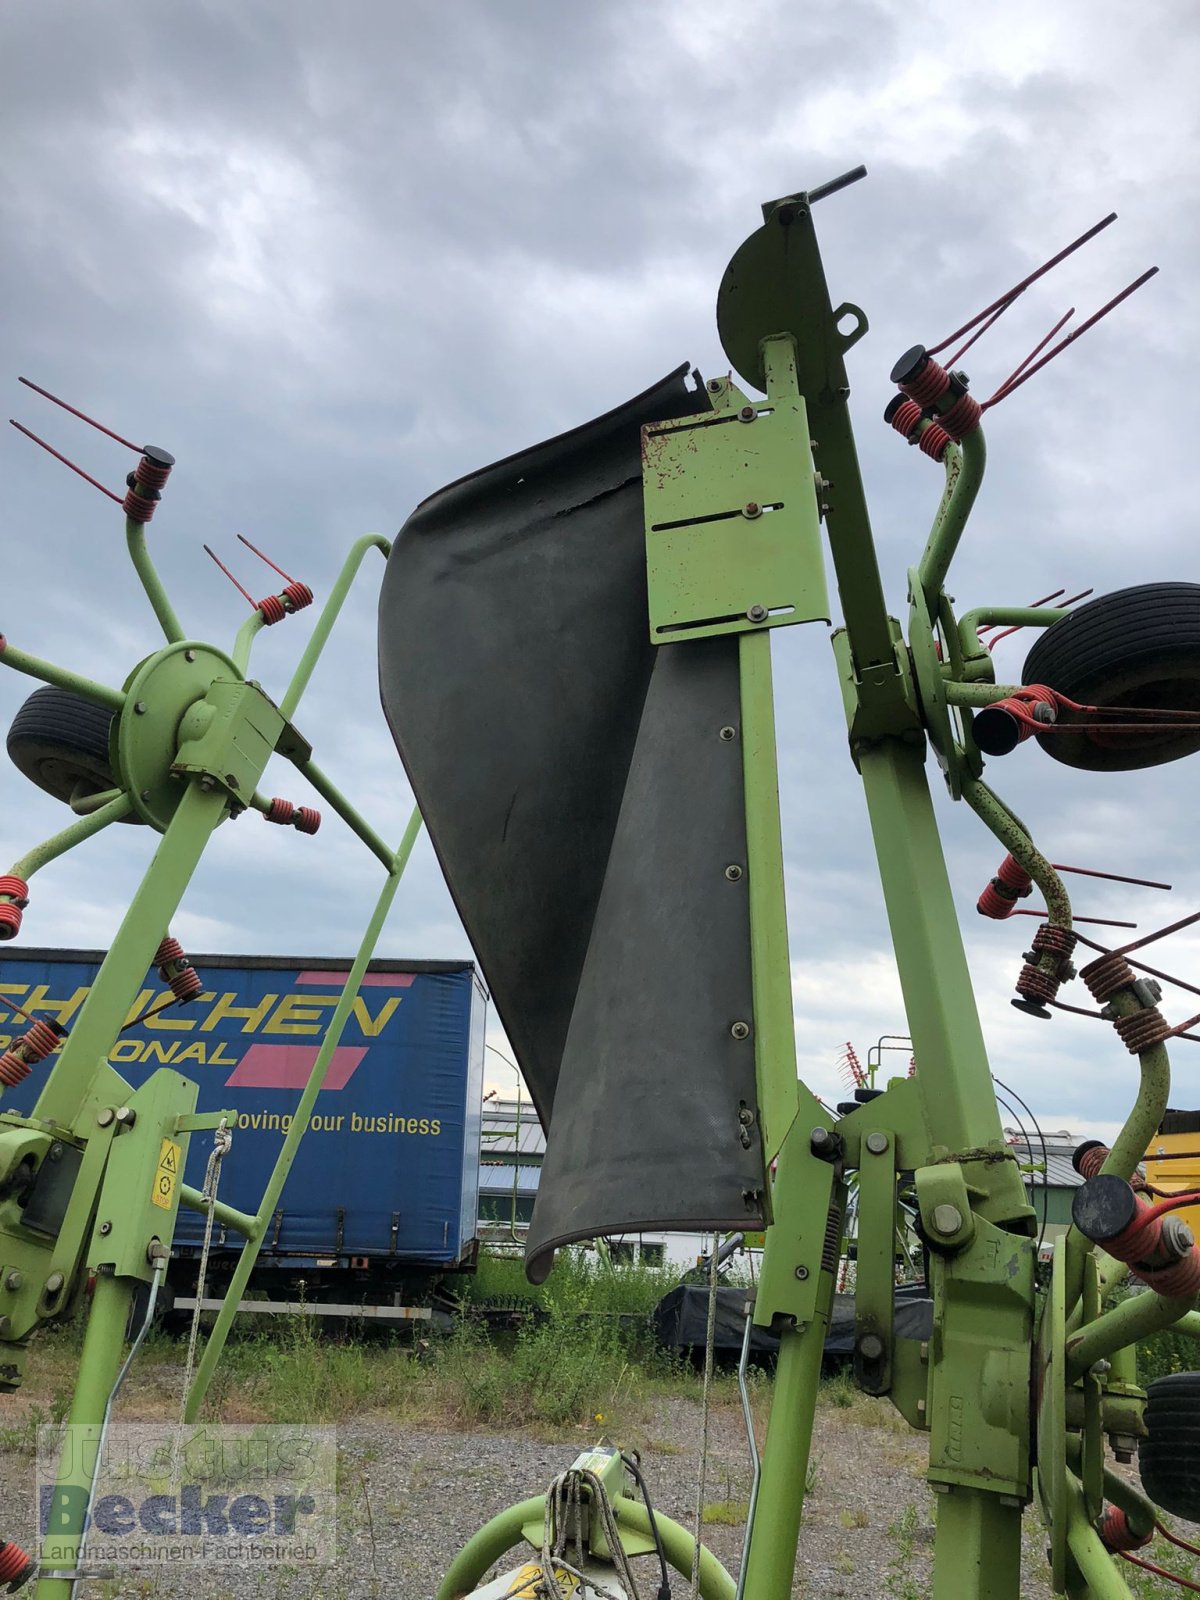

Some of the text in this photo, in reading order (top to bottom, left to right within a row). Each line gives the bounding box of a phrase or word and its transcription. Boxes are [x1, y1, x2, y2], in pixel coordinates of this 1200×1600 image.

[237, 1110, 441, 1136] oving our business
